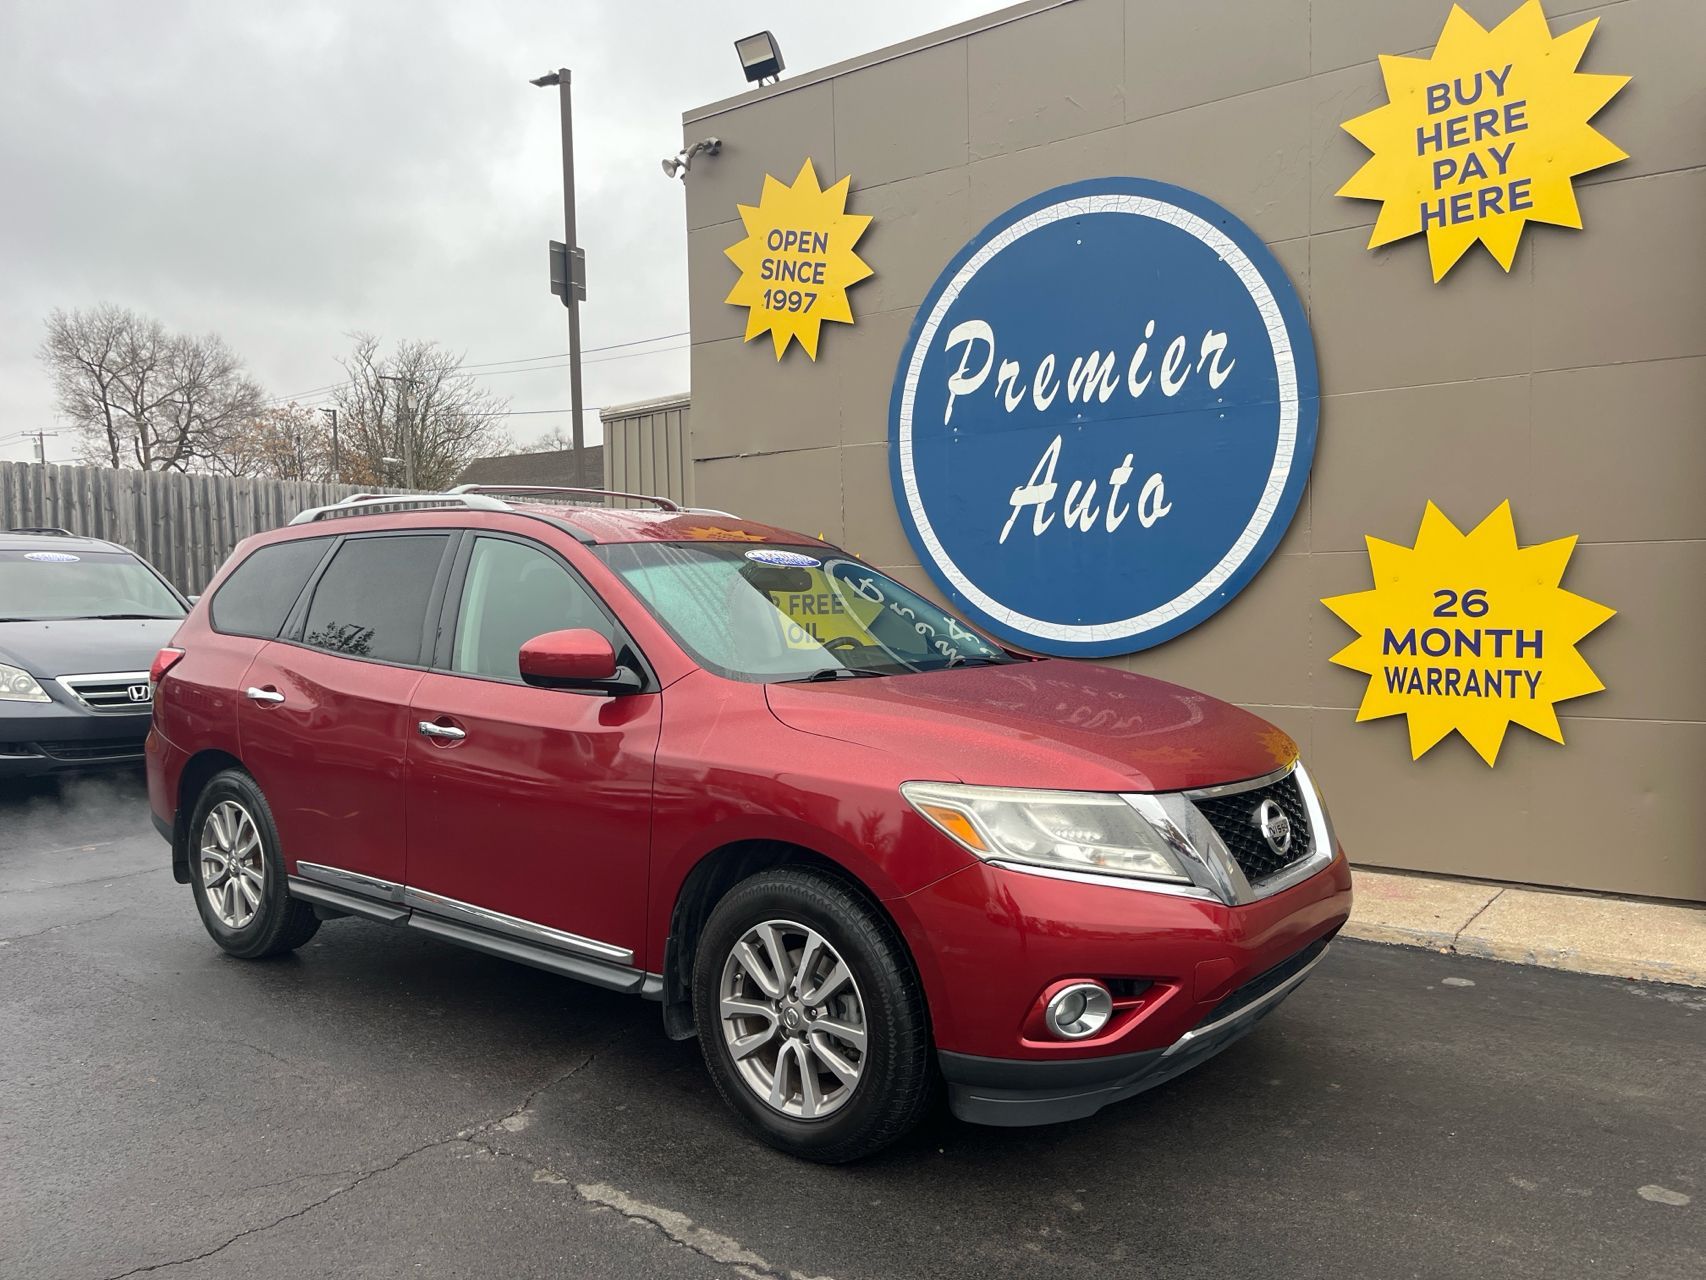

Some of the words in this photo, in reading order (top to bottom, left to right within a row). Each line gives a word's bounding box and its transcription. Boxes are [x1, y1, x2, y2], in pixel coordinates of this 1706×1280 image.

[1426, 63, 1513, 116] BUY
[1416, 99, 1529, 157] HERE
[1432, 142, 1516, 191] PAY
[1420, 178, 1533, 232] HERE
[767, 229, 829, 254] OPEN
[760, 258, 827, 285] SINCE
[763, 288, 818, 314] 1997
[944, 319, 1236, 426] Premier
[999, 434, 1173, 545] Auto
[789, 593, 845, 616] FREE
[1432, 588, 1490, 618] 26
[787, 622, 826, 645] OIL
[1382, 627, 1543, 659] MONTH
[1383, 666, 1543, 700] WARRANTY
